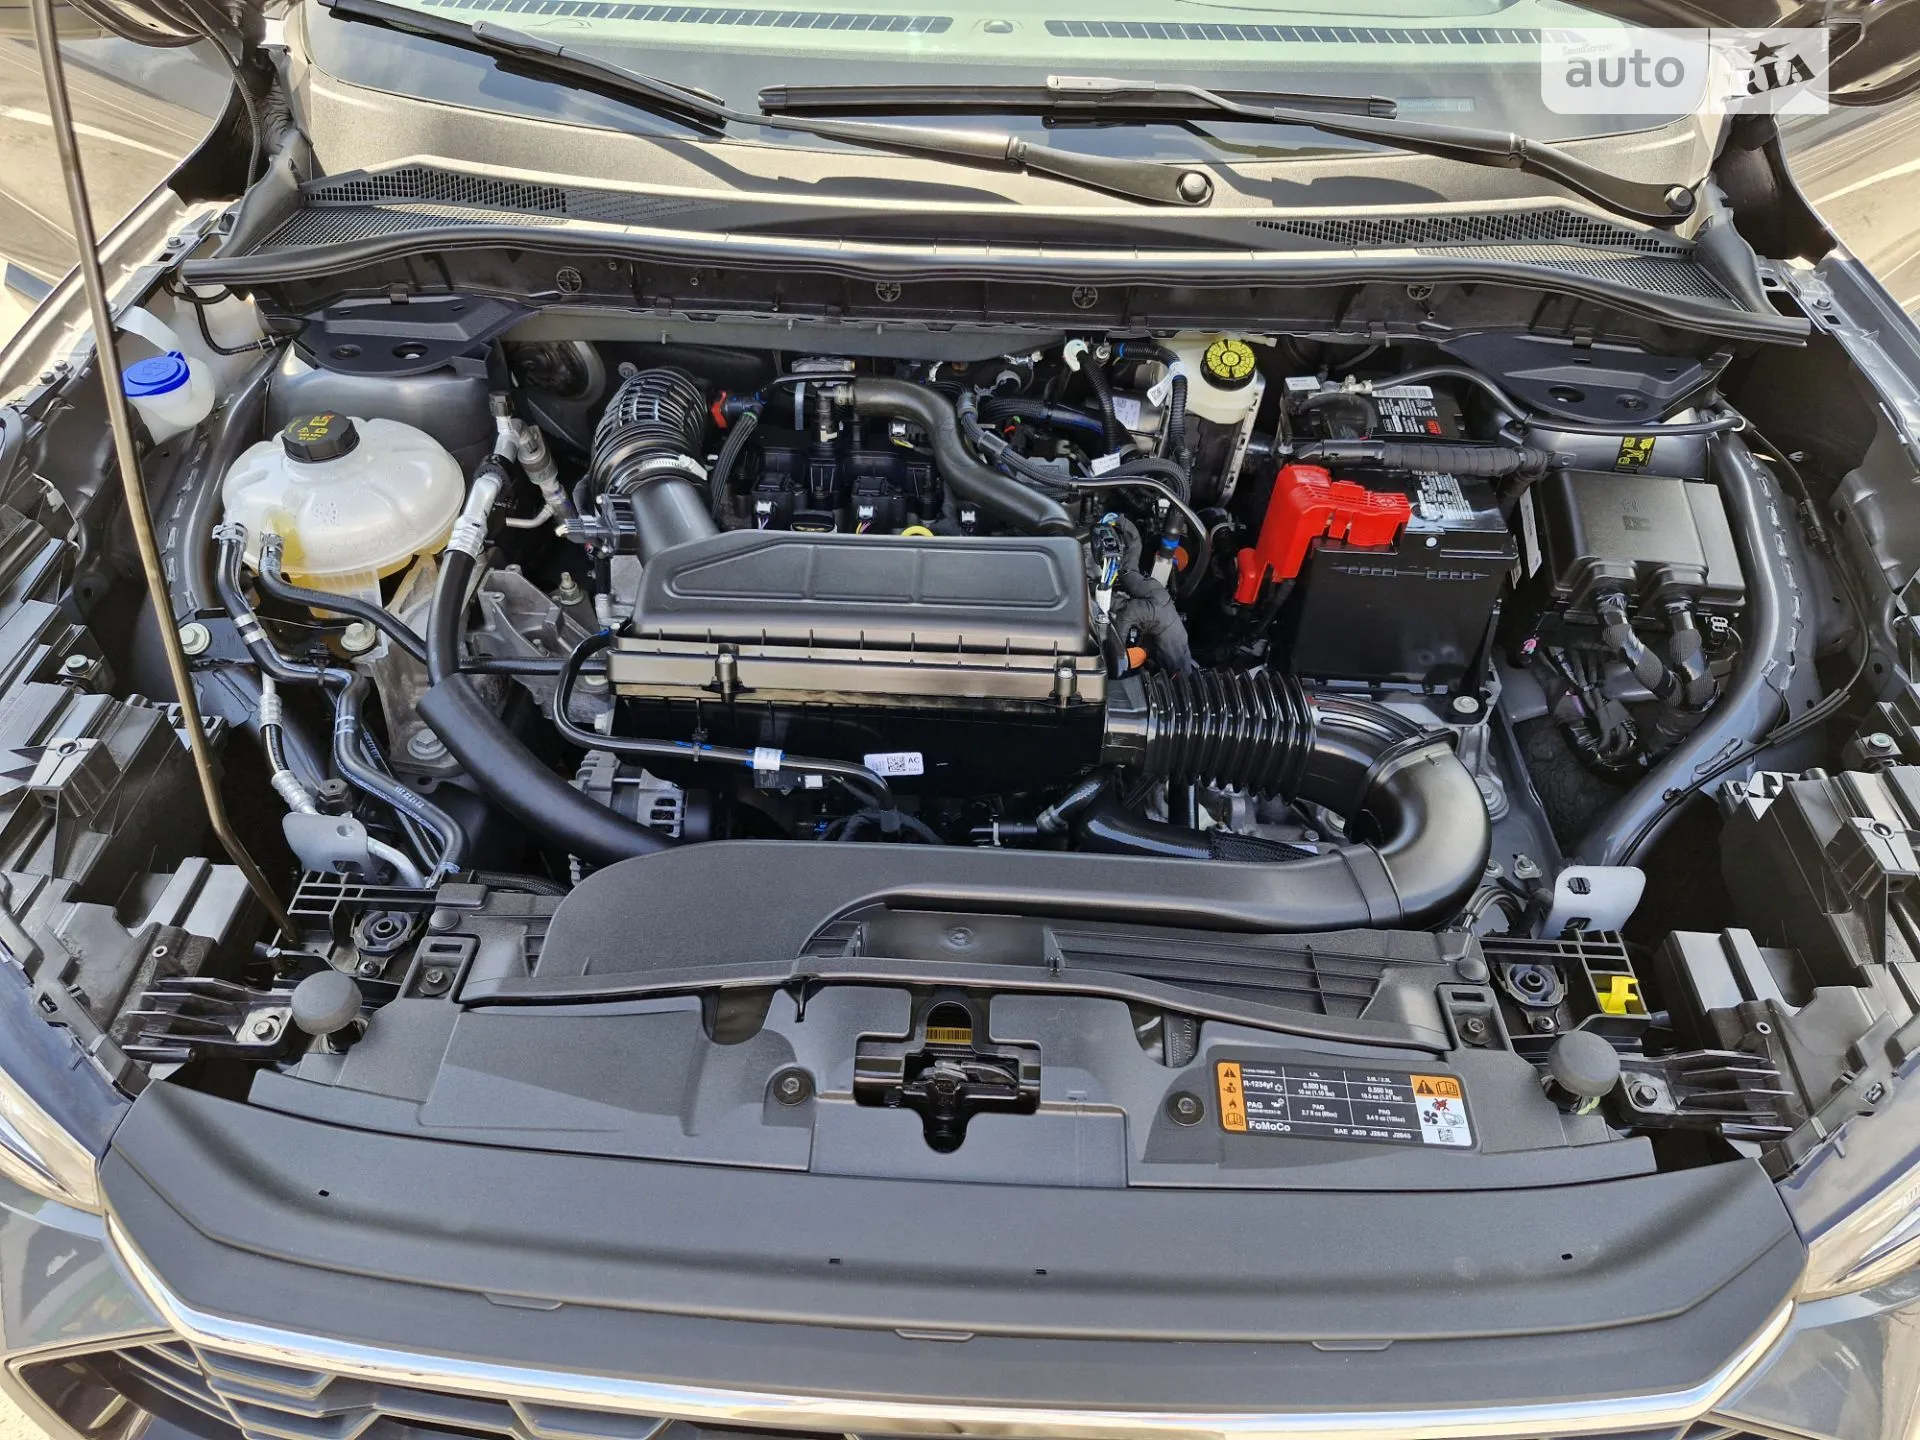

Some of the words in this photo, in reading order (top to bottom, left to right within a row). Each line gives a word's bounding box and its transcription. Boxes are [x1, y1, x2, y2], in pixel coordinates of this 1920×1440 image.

[1243, 1080, 1274, 1090] R-1234yf
[1319, 1084, 1329, 1092] kg
[1385, 1087, 1394, 1096] kg
[1247, 1101, 1263, 1109] PAG
[1248, 1120, 1291, 1132] FoMoCo
